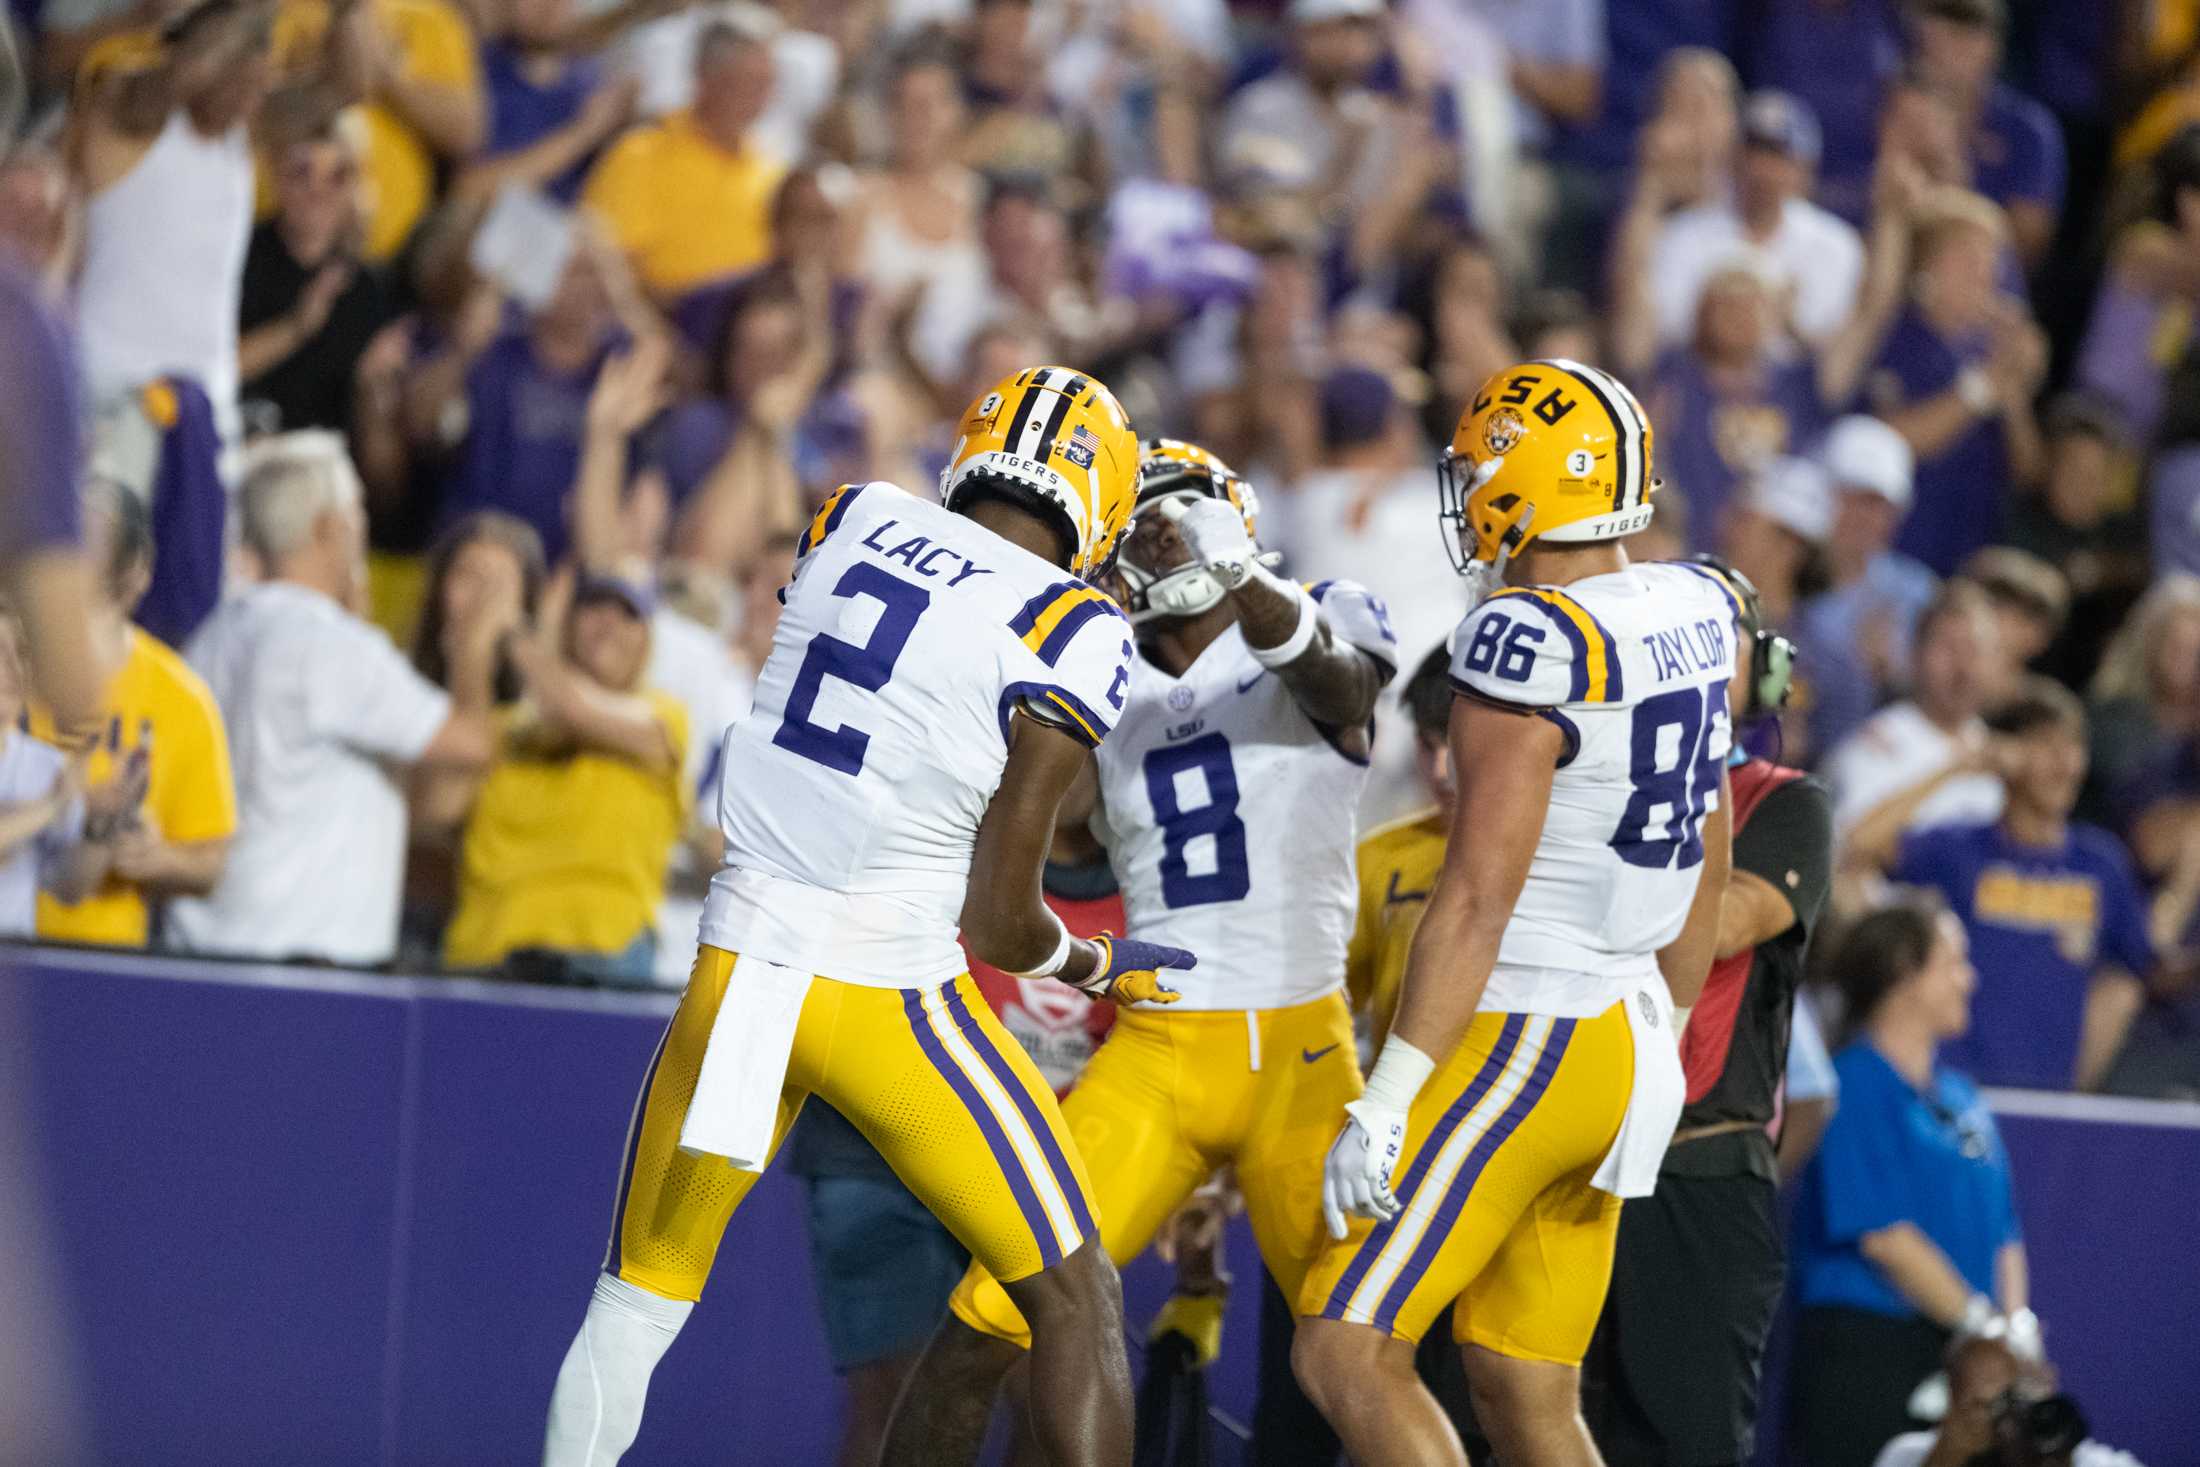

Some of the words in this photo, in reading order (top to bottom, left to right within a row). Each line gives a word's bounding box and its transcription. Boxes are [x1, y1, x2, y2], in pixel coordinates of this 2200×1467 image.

[984, 396, 997, 412] 3
[990, 453, 1059, 485] TIGERS
[1574, 454, 1586, 472] 3
[861, 520, 995, 587] LACY
[772, 560, 931, 777] 2
[1464, 612, 1546, 683] 86
[1642, 618, 1726, 682] TAYLOR
[1165, 720, 1204, 741] LSU
[1607, 678, 1729, 870] 86
[1143, 731, 1250, 909] 8
